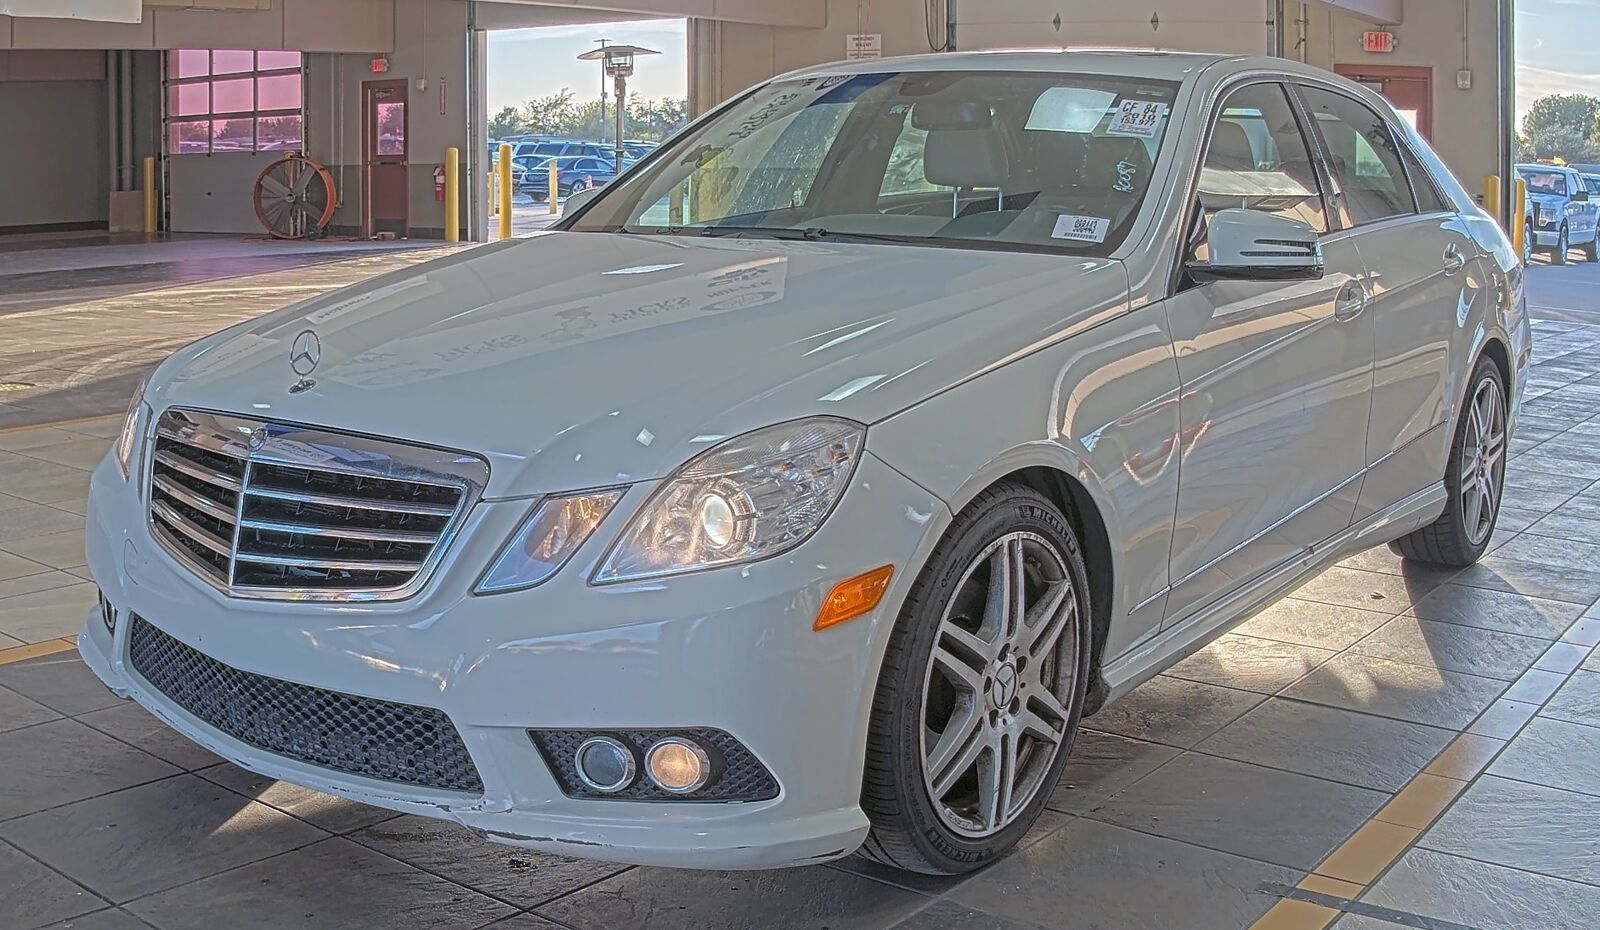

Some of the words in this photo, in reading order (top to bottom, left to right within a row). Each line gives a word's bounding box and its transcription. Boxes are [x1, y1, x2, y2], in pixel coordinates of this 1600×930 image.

[1367, 32, 1390, 49] EXIT
[1122, 102, 1139, 113] CF
[1143, 103, 1159, 114] 84
[1123, 112, 1156, 121] 2010
